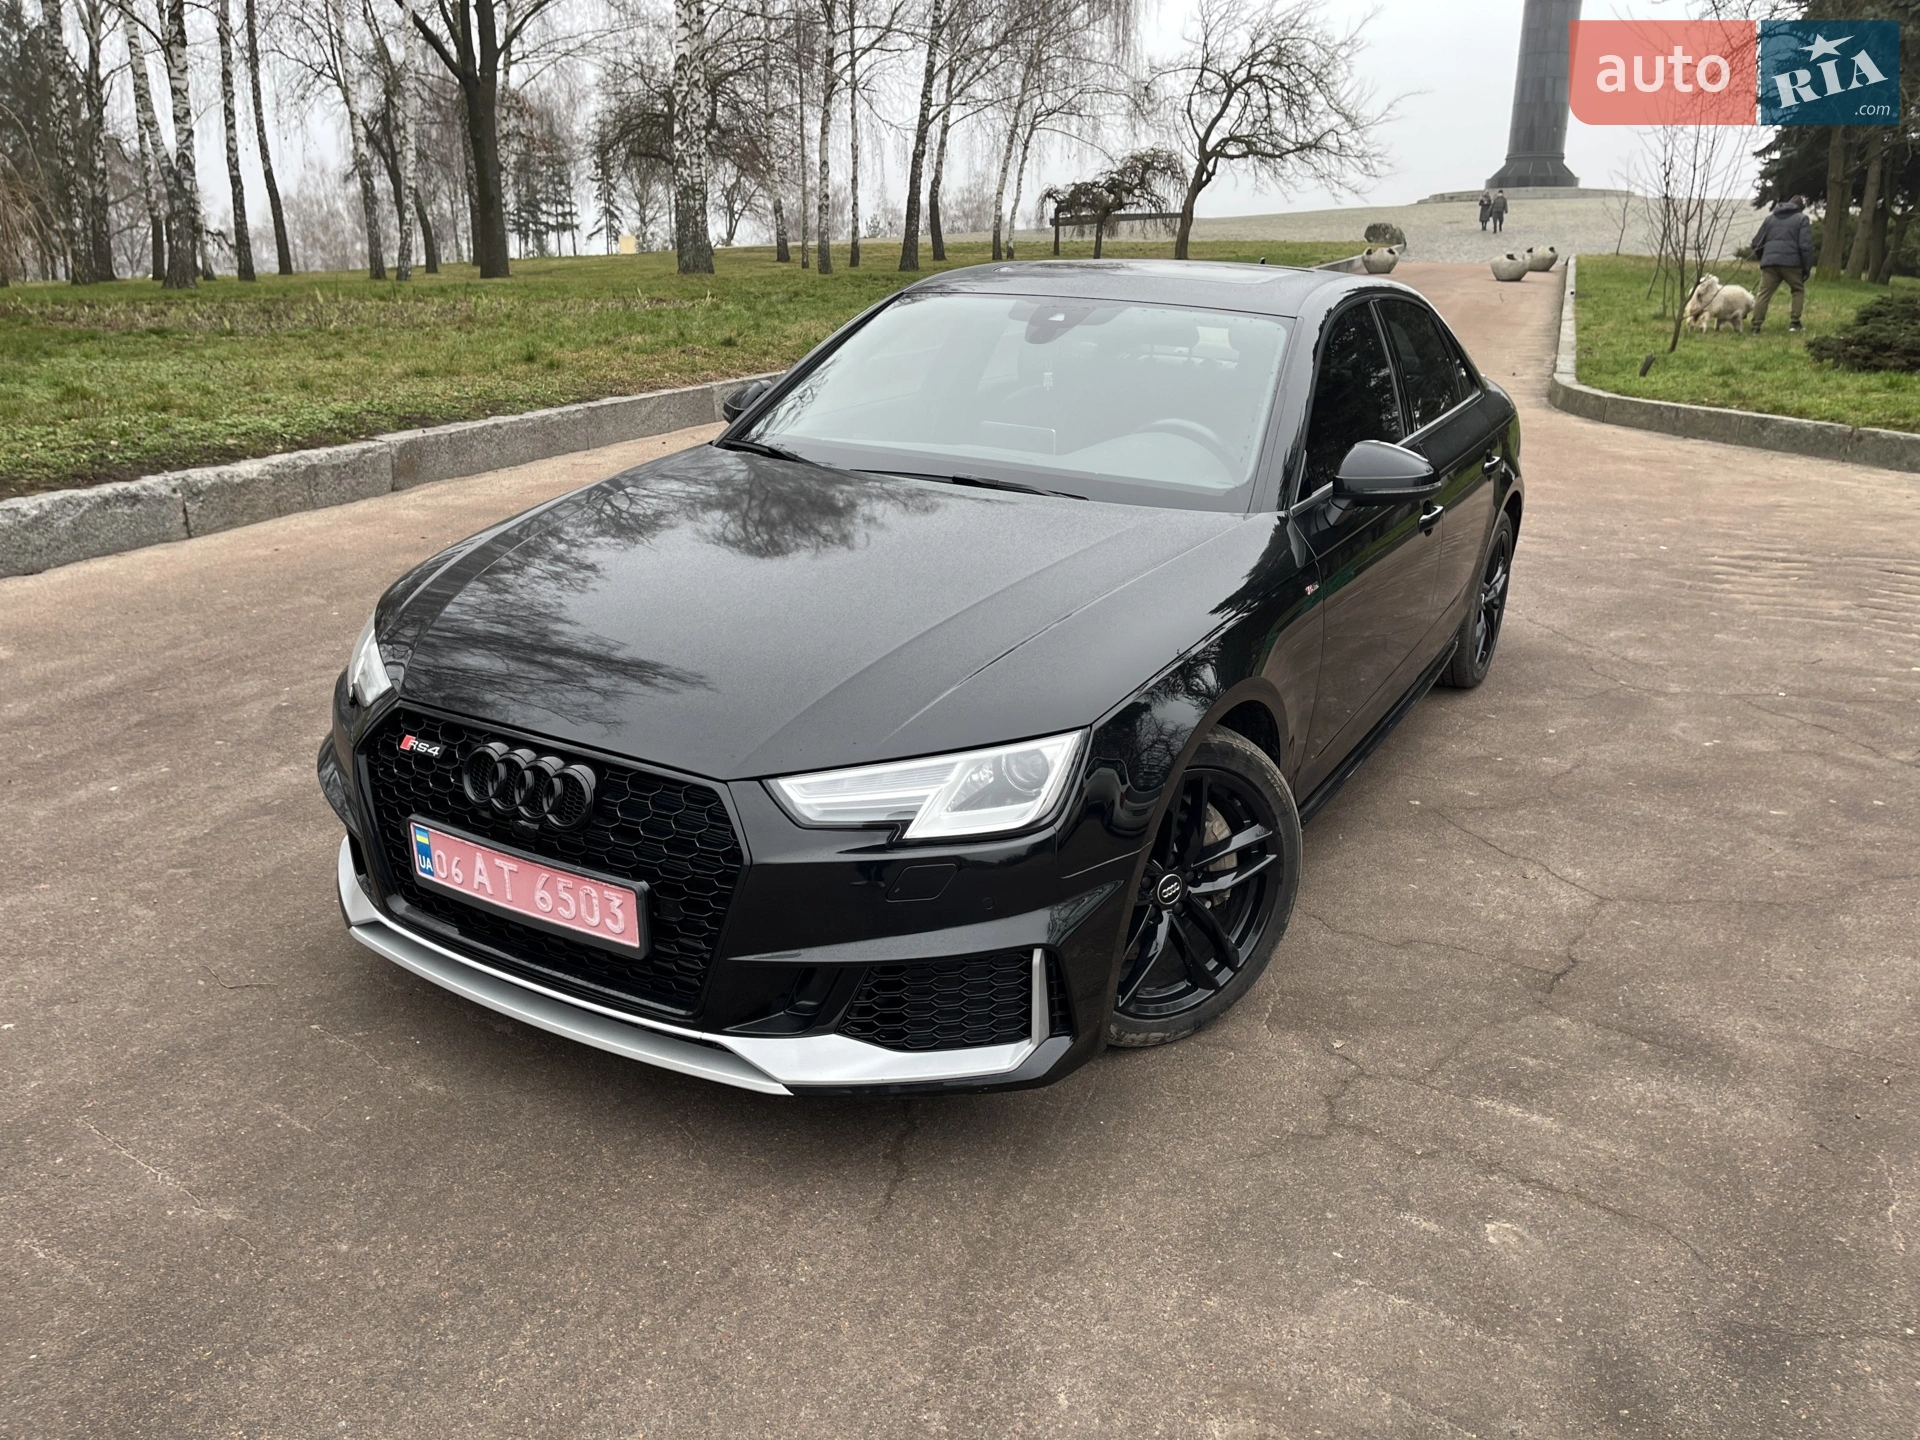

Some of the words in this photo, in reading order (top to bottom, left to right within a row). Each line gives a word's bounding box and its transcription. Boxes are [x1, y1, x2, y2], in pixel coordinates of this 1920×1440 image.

[407, 738, 441, 757] RS4
[418, 853, 434, 872] UA
[434, 849, 464, 885] 06
[473, 852, 519, 902] AT
[533, 873, 626, 935] 6503
